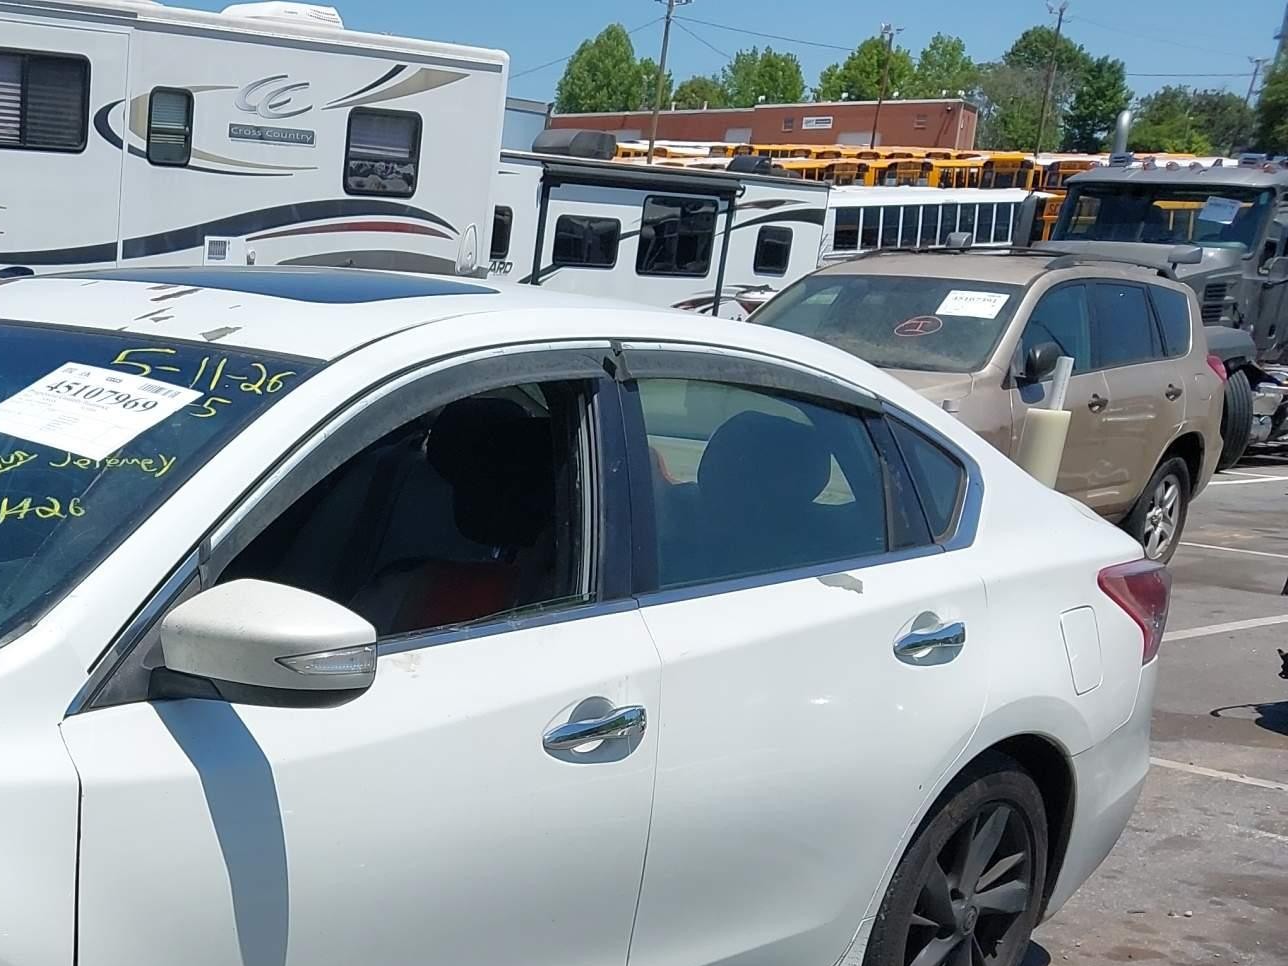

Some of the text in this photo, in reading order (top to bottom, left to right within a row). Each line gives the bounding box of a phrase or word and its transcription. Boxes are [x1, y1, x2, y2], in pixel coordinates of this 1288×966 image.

[231, 126, 313, 142] Cross Country
[46, 379, 159, 413] 45107969
